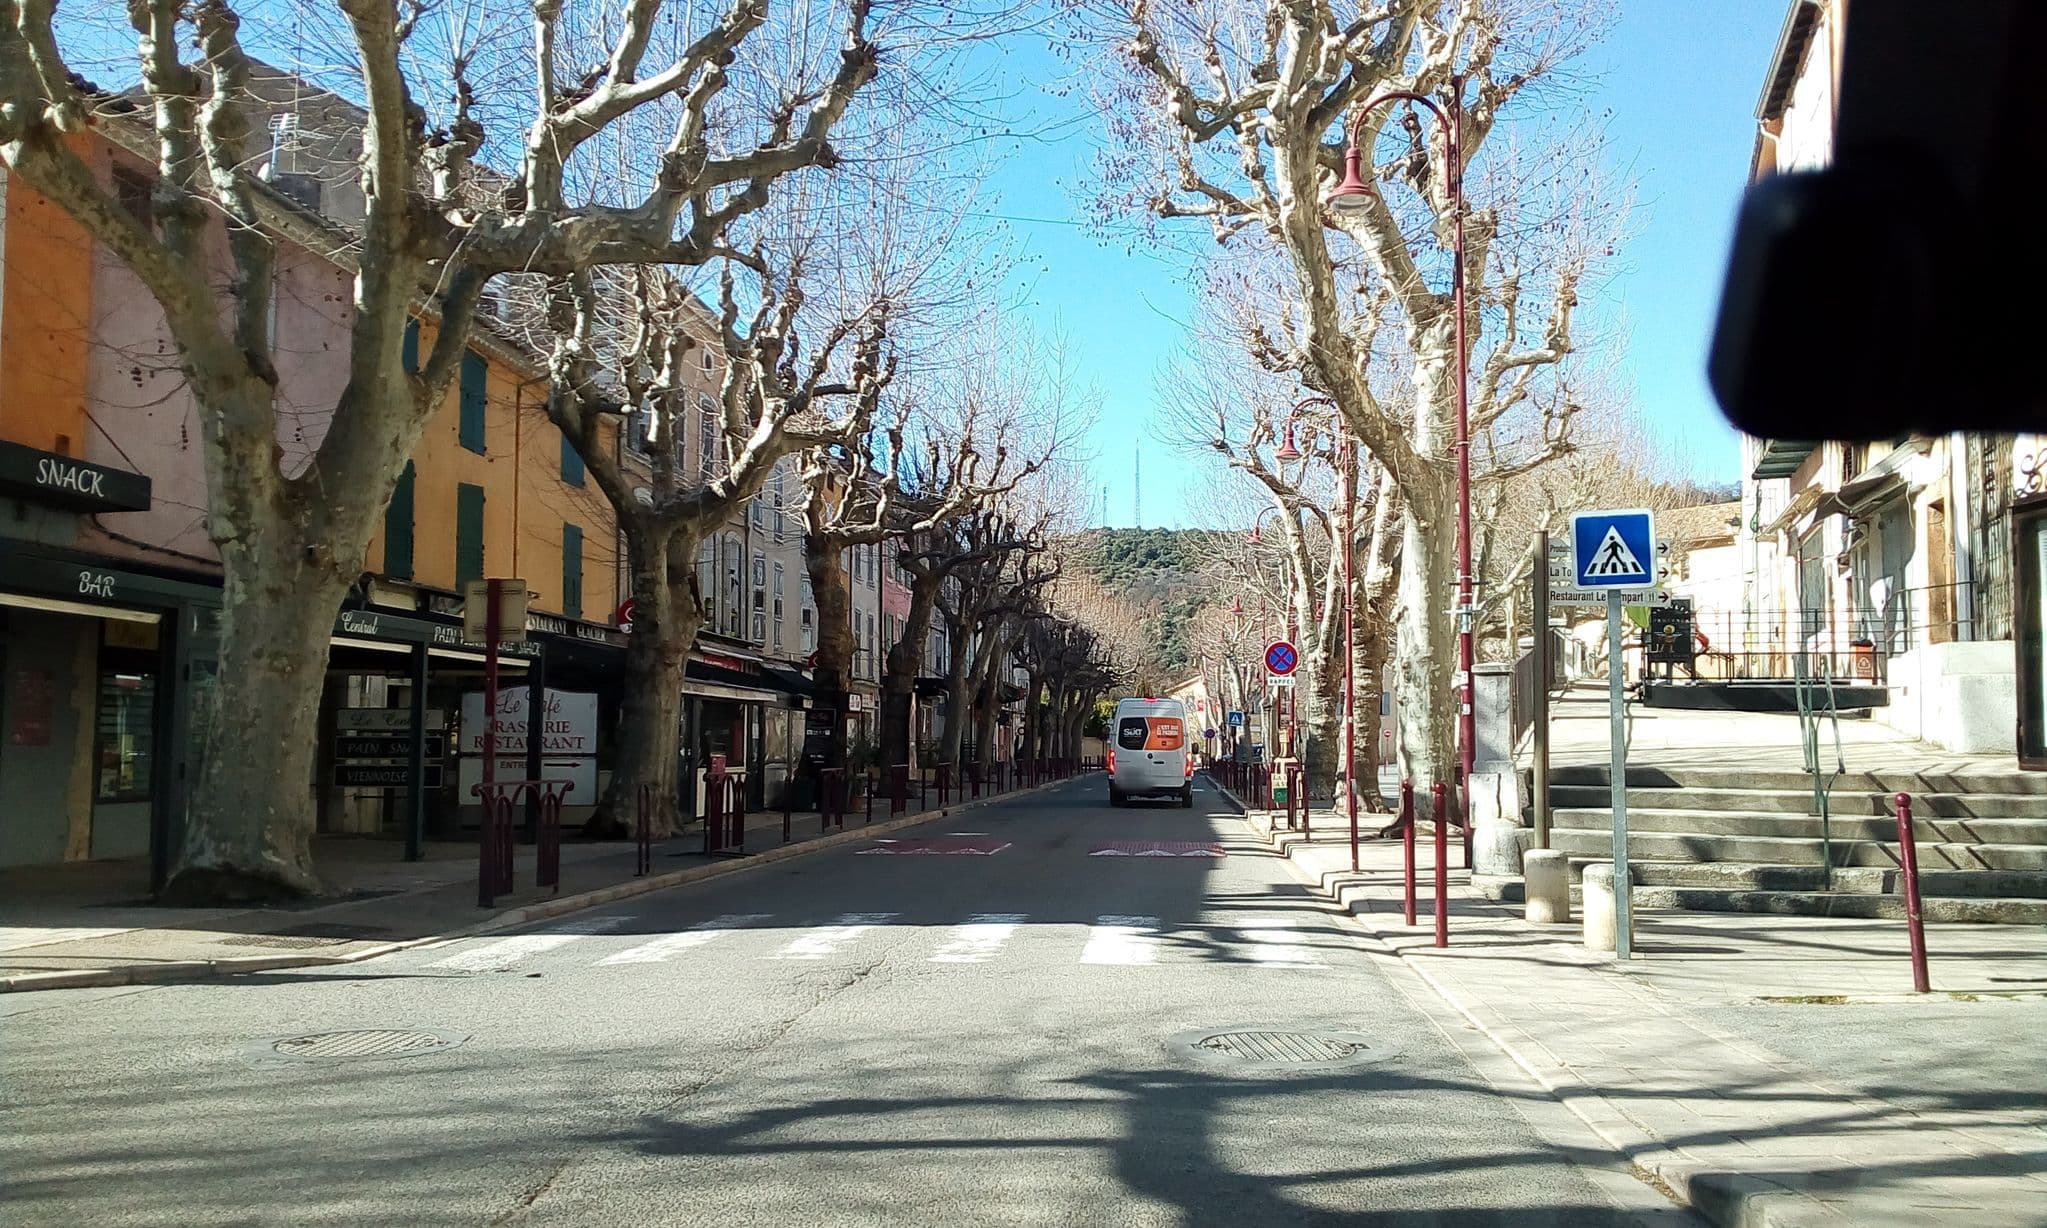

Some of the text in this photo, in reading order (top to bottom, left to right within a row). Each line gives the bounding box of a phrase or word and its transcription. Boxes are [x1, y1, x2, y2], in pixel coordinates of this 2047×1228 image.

[36, 458, 105, 498] SNACK
[1550, 566, 1572, 577] La To
[79, 571, 115, 597] BAR
[1550, 591, 1594, 601] Restaurant
[1597, 591, 1607, 601] Le
[341, 612, 379, 635] Central
[434, 626, 457, 645] PAIN
[496, 690, 522, 714] Le
[474, 735, 586, 750] RSTARANT
